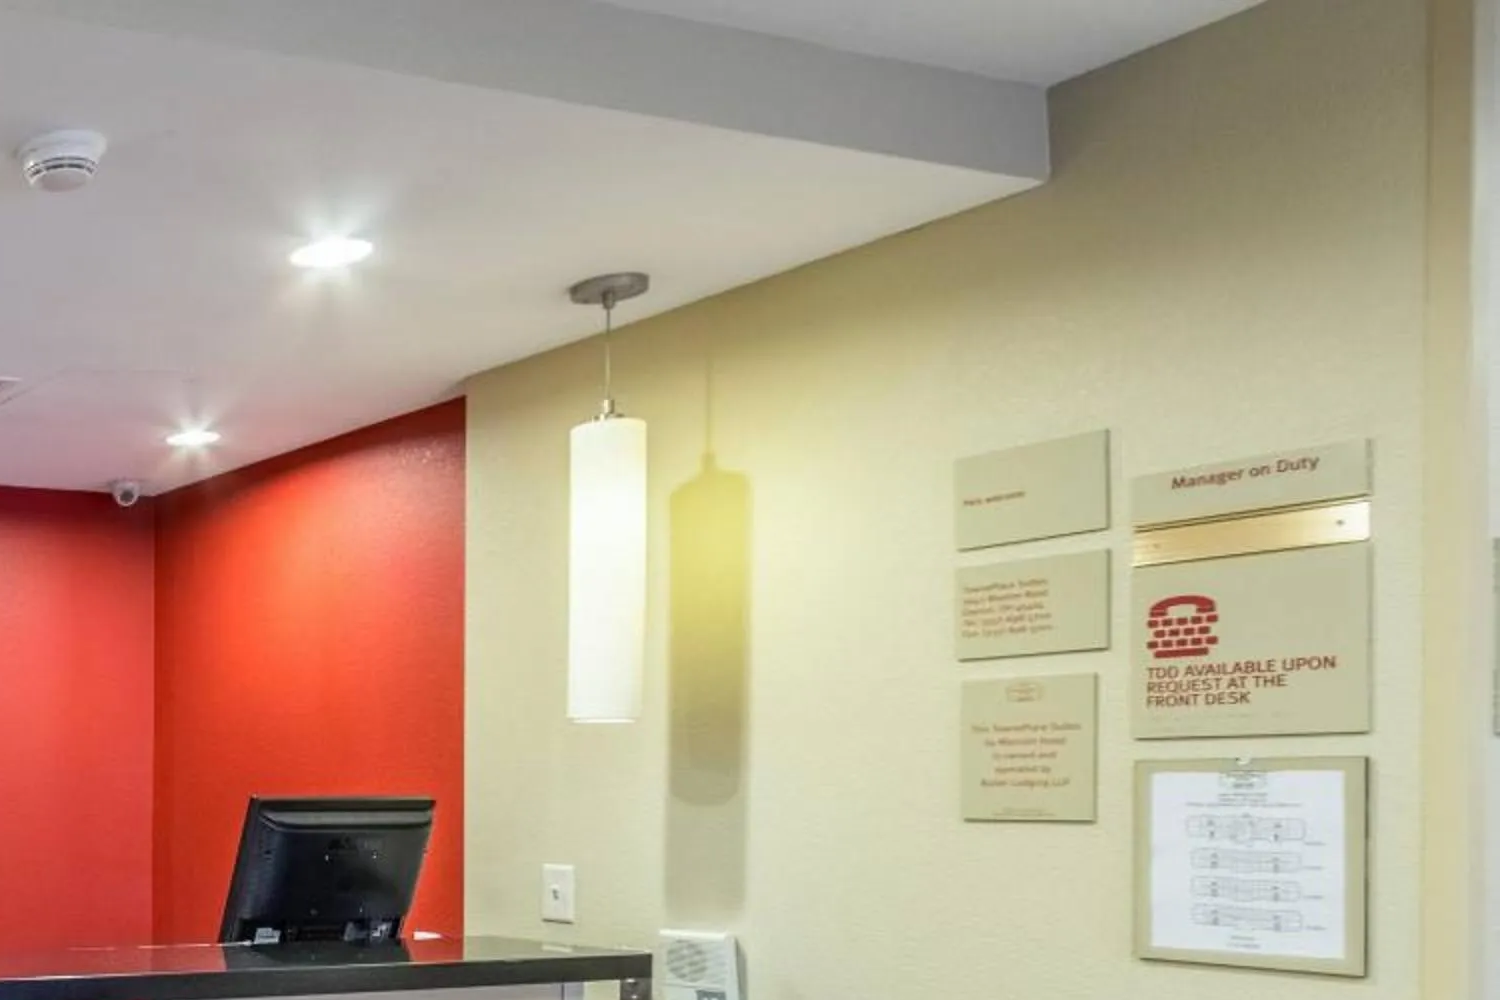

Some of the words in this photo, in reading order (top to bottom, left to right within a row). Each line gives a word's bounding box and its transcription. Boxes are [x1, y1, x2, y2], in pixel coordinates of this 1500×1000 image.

[1171, 468, 1244, 490] Manager
[1248, 465, 1271, 478] on
[1276, 456, 1320, 473] Duty
[1146, 666, 1180, 680] TDD
[1184, 659, 1277, 676] AVAILABLE
[1282, 656, 1336, 671] UPON
[1146, 677, 1223, 694] REQUEST
[1226, 675, 1248, 690] AT
[1252, 673, 1289, 688] THE
[1146, 693, 1200, 708] FRONT
[1205, 691, 1251, 705] DESK
